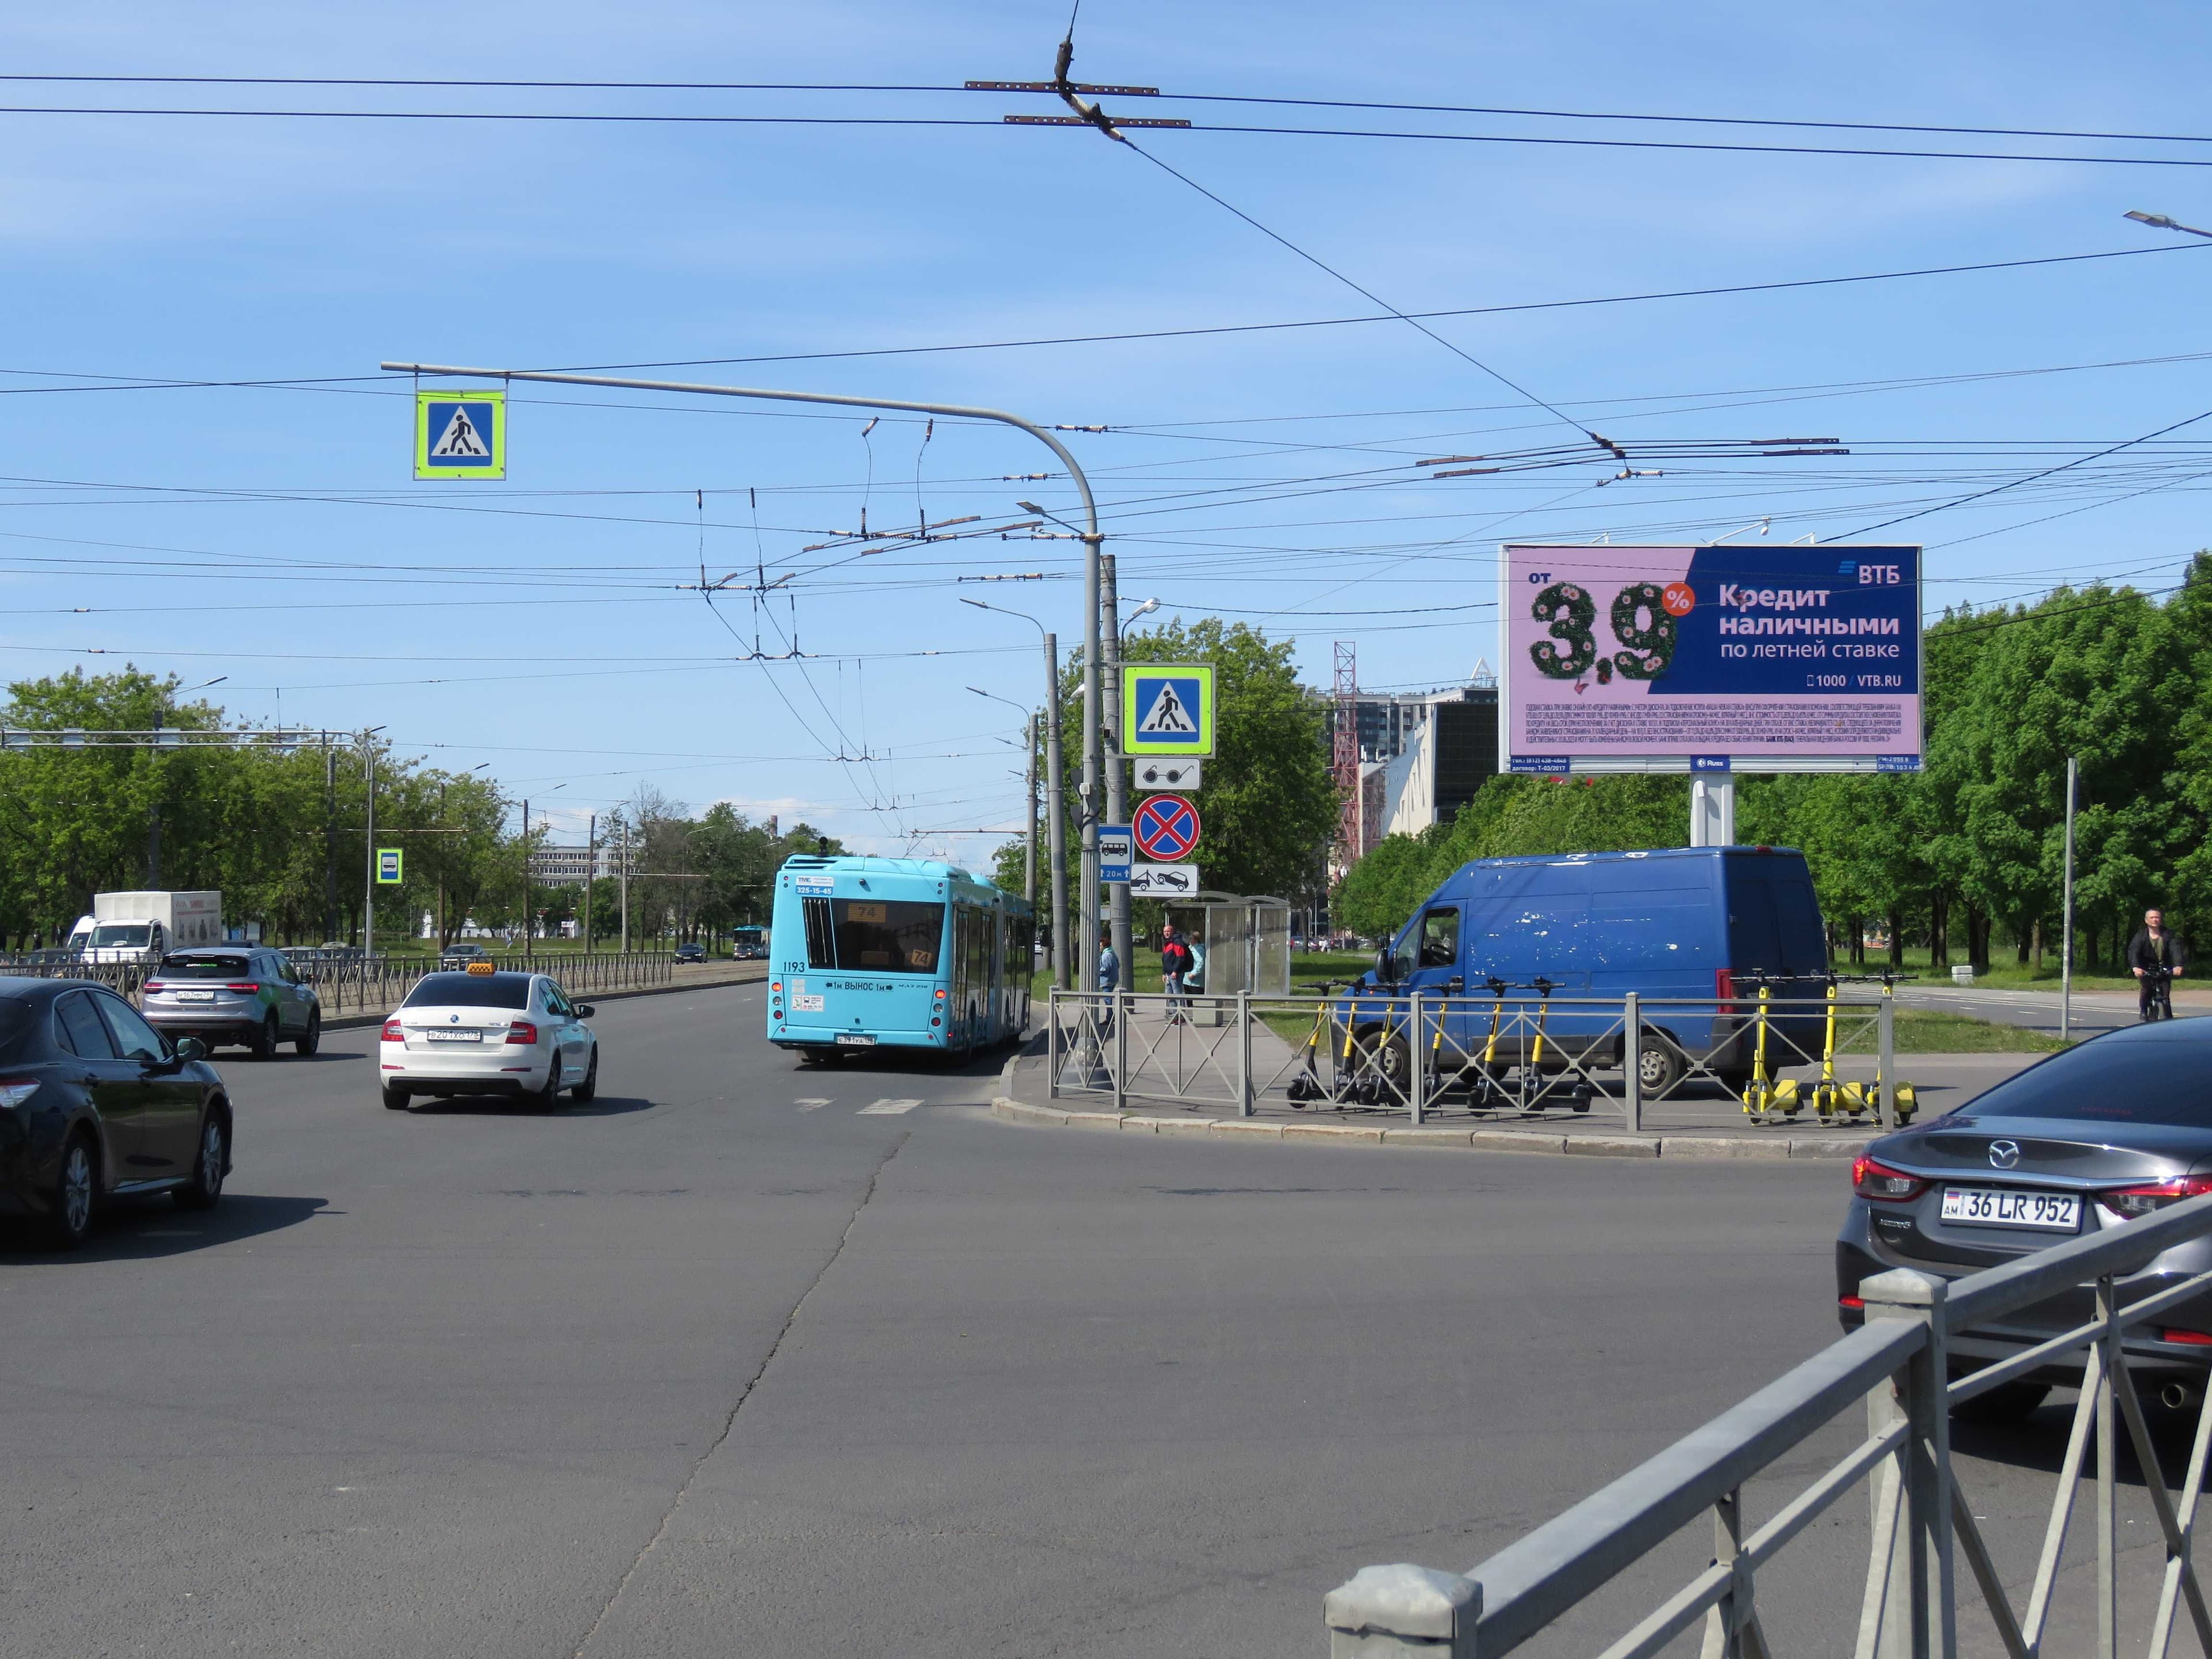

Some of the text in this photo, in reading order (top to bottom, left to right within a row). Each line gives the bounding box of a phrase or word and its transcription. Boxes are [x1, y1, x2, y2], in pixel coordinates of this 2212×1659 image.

[1528, 573, 1551, 584] от
[1858, 565, 1900, 584] ВТБ
[1719, 584, 1830, 612] Кредит
[1529, 581, 1690, 685] 3,9 %
[1719, 618, 1899, 634] наличными
[1721, 639, 1900, 658] по летней ставке
[1816, 675, 1846, 687] 1000
[1857, 675, 1901, 687] VTB.RU
[858, 907, 876, 918] 74
[914, 951, 928, 964] 74
[783, 961, 805, 972] 1193
[844, 982, 873, 991] ВЫНОС
[1944, 1192, 2073, 1223] AM 36 LR 952
